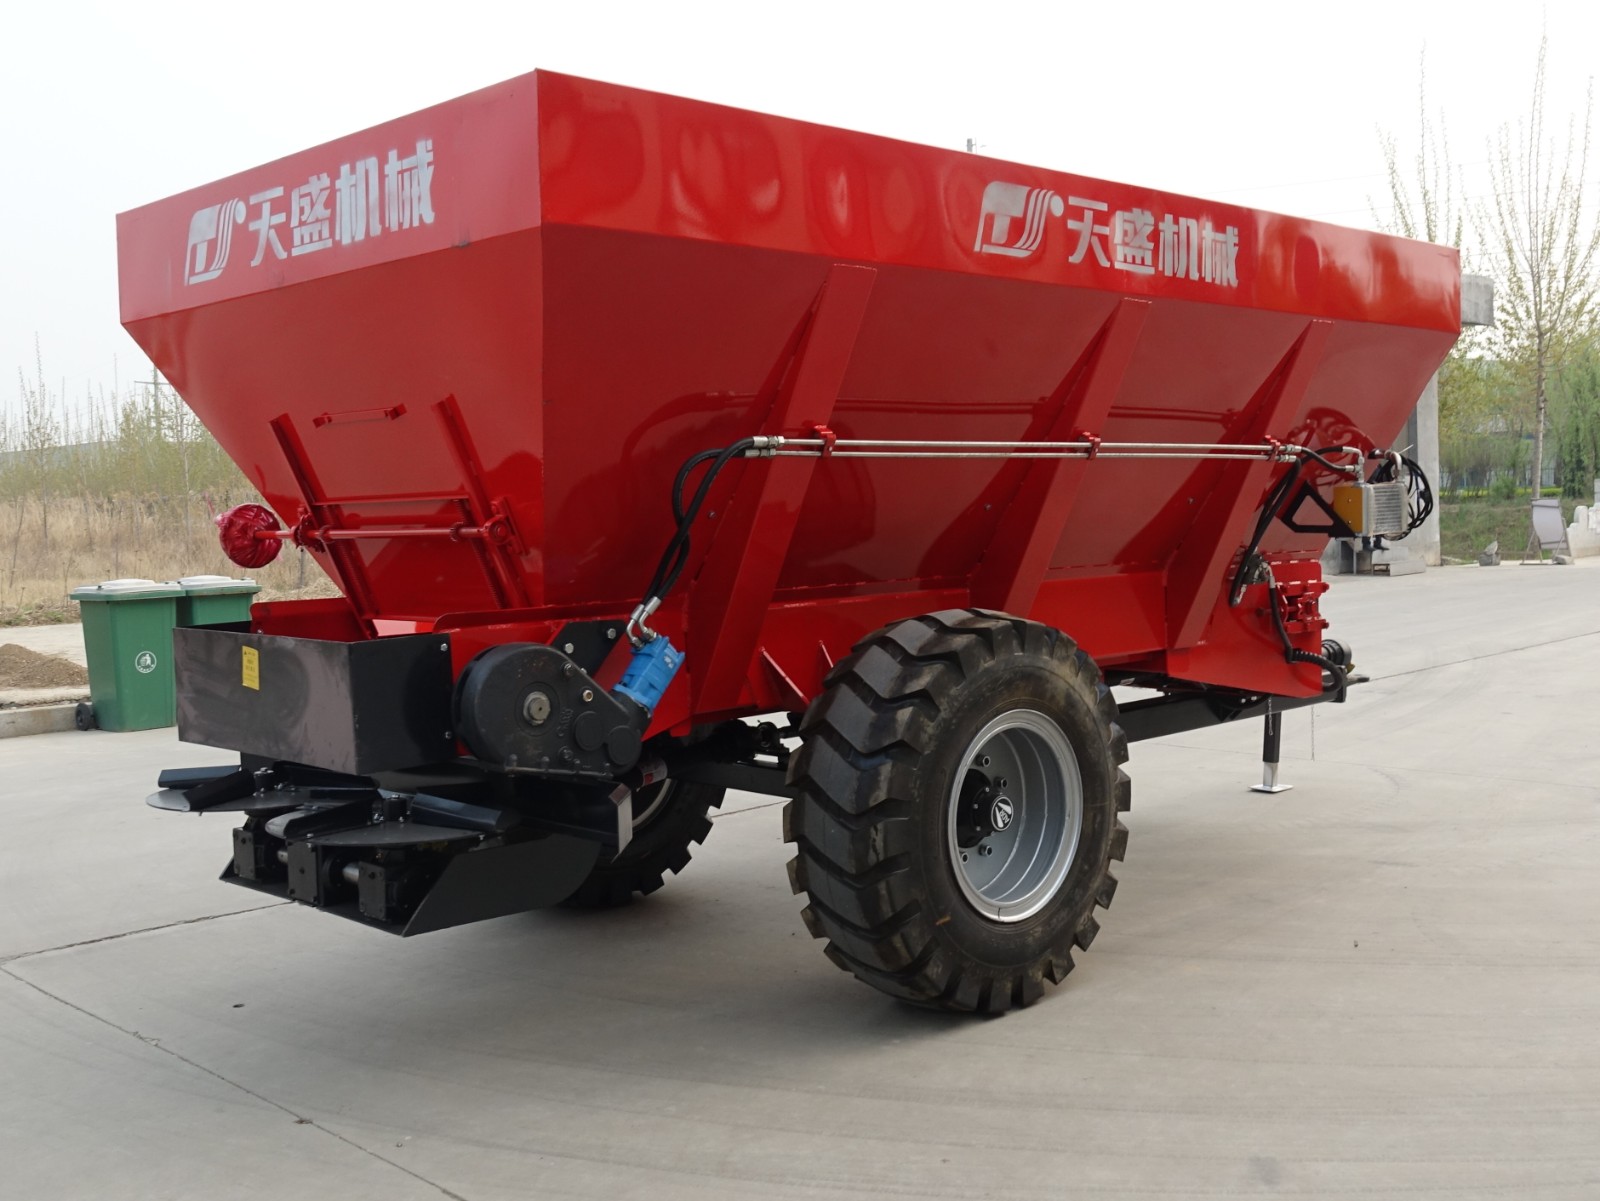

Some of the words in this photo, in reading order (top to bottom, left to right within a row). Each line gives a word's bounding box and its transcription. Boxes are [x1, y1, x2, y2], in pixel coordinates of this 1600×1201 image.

[249, 138, 435, 267] 天盛机械
[1067, 195, 1239, 288] 天盛机械
